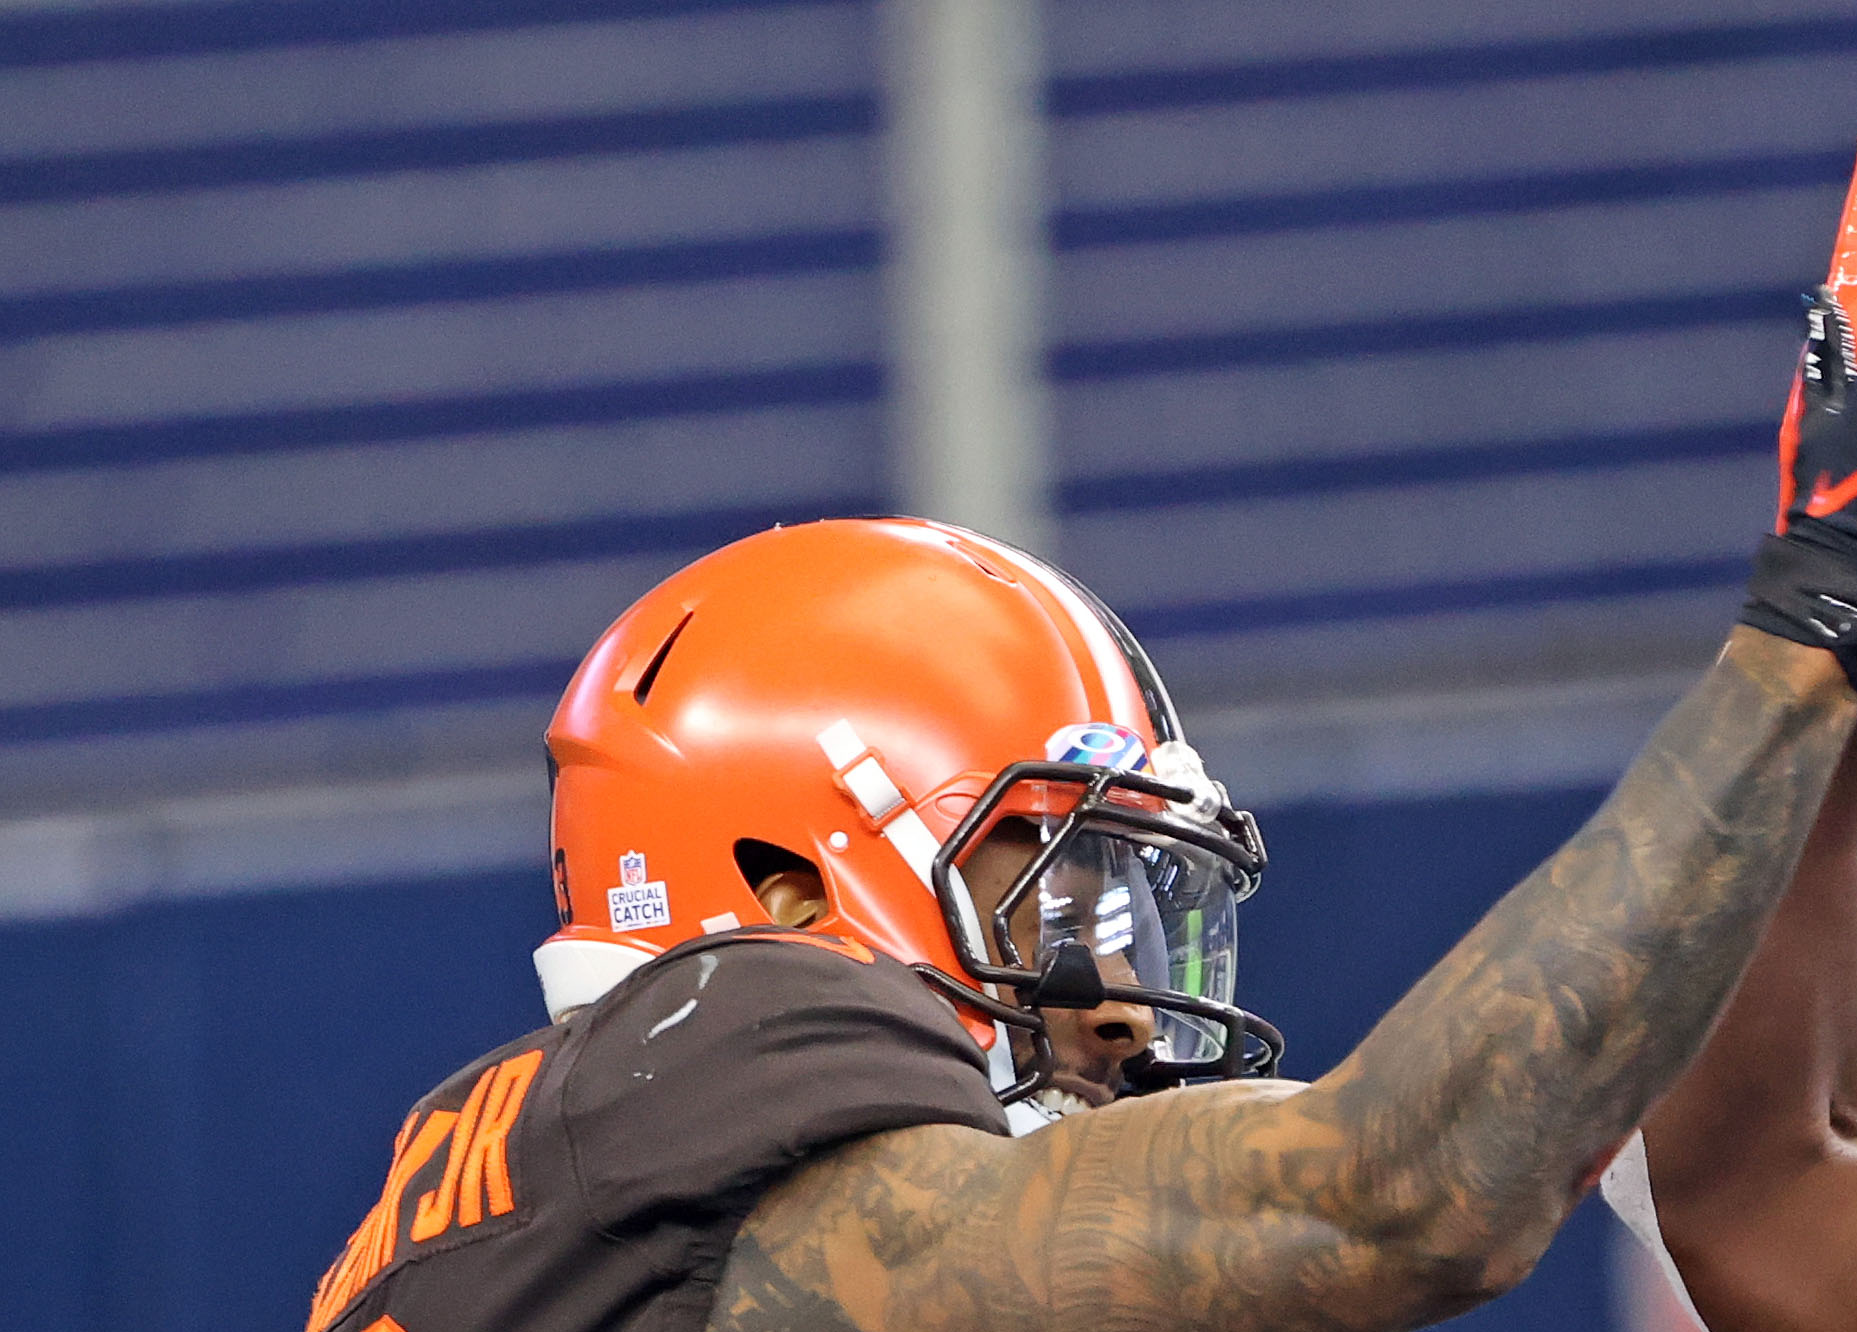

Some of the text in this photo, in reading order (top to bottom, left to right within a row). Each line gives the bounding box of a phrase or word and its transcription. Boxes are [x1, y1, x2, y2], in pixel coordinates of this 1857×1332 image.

[612, 887, 662, 905] CRUCIAL
[613, 901, 665, 924] CATCH
[410, 1049, 545, 1243] JR
